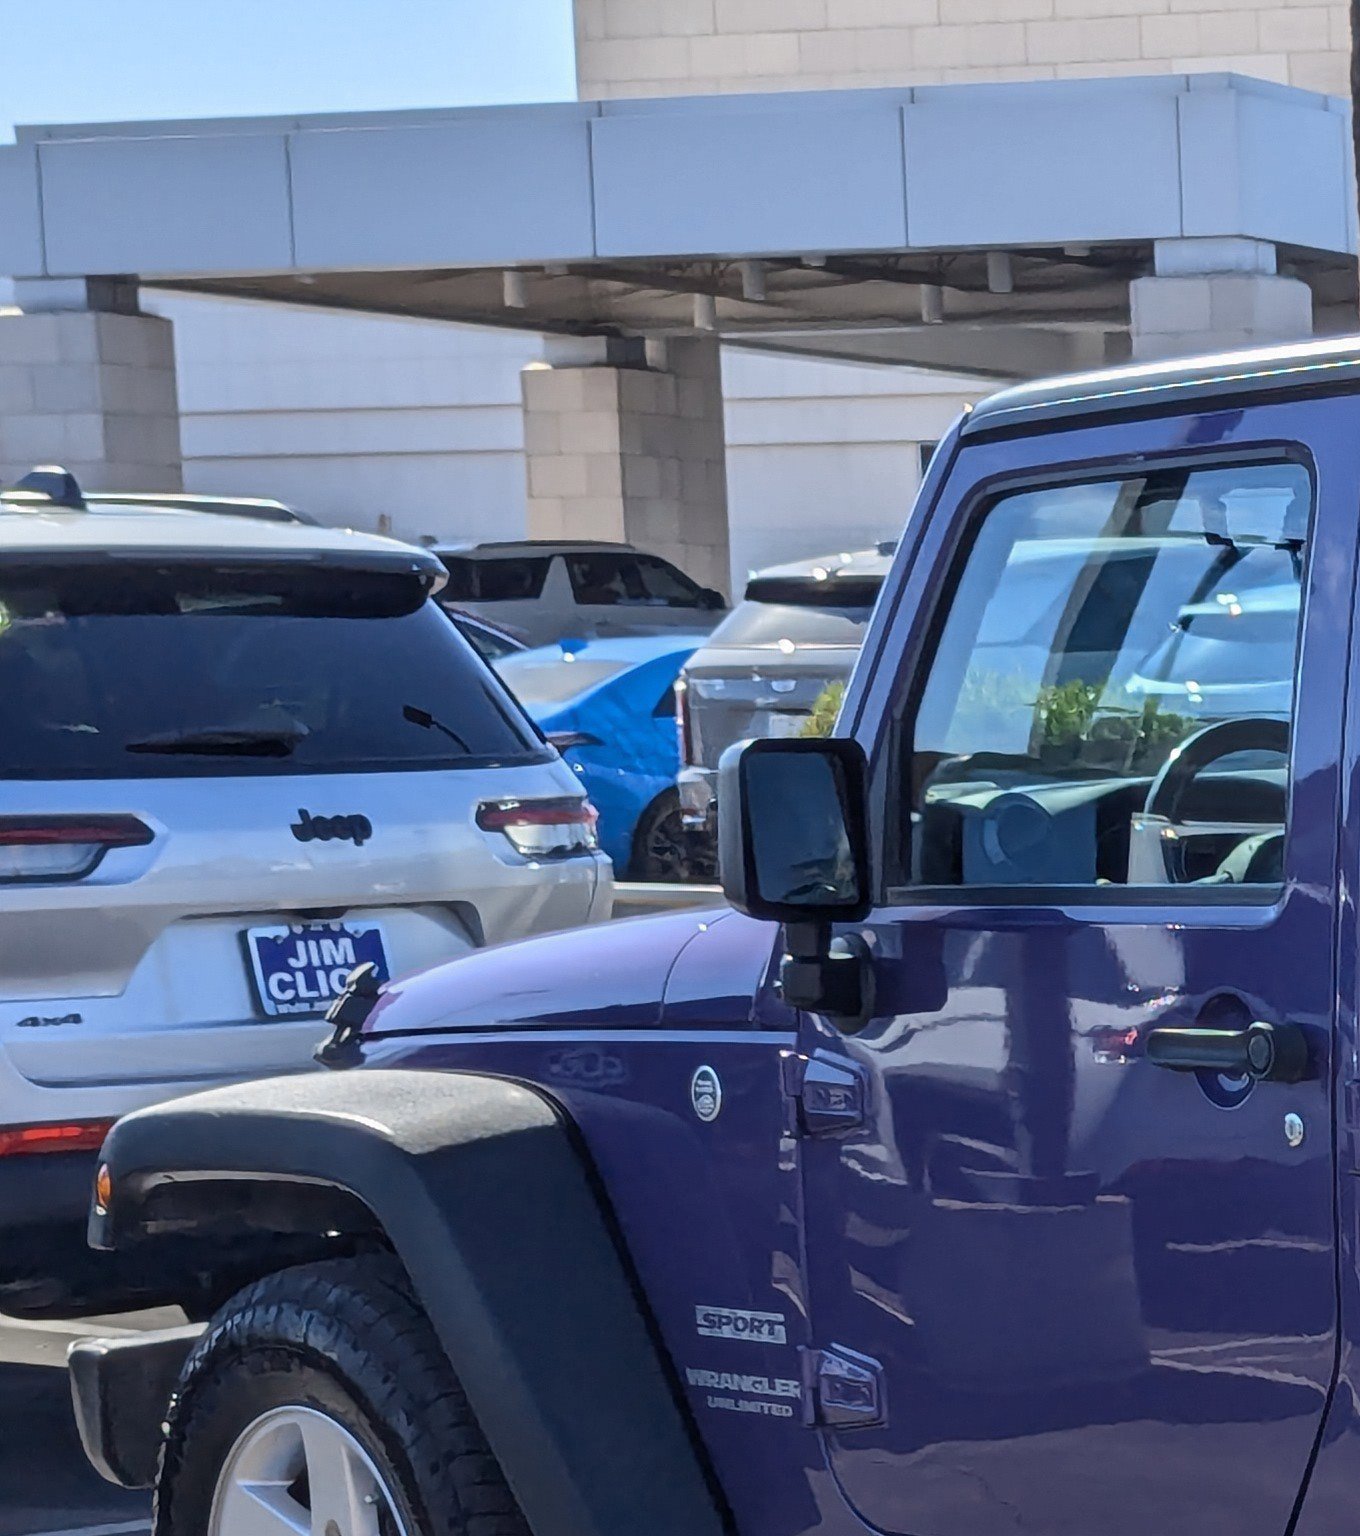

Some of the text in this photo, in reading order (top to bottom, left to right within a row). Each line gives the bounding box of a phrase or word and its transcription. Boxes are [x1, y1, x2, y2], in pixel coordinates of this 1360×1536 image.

[290, 807, 373, 847] Jeep
[286, 937, 357, 969] JIM
[268, 967, 355, 1001] CLIC
[697, 1310, 785, 1338] SPORT
[685, 1367, 801, 1399] WRANGLER
